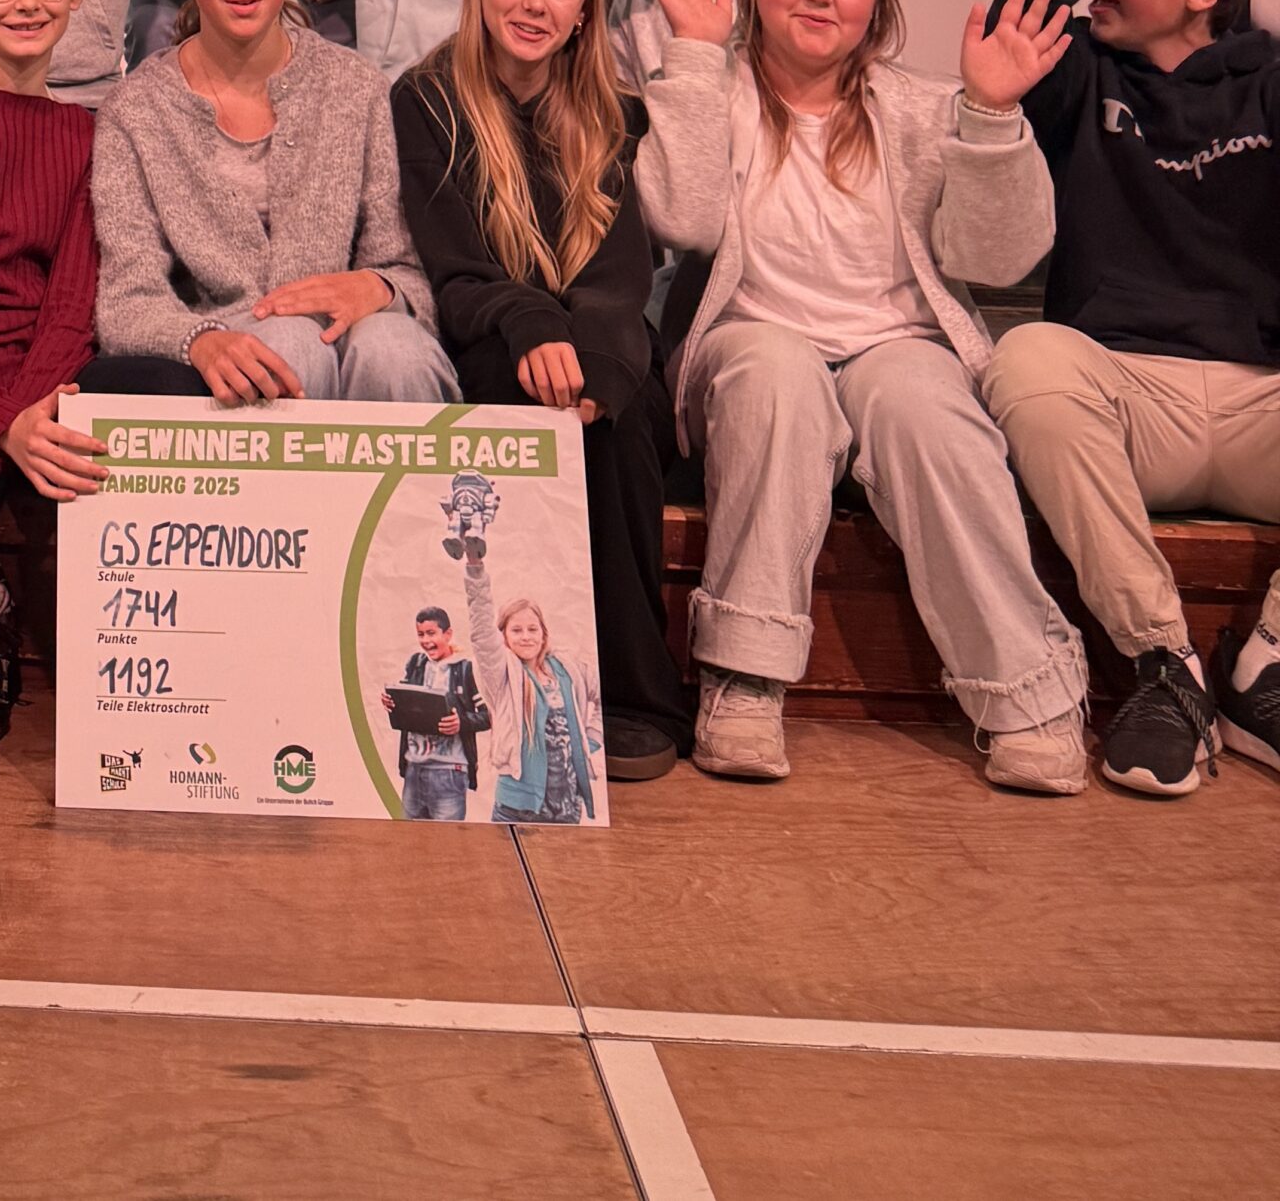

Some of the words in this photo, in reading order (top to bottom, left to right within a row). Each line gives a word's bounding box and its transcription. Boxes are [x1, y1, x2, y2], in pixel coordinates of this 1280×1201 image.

[107, 426, 270, 463] GEWINNER
[283, 431, 437, 466] E-WASTE
[449, 435, 540, 469] RACE
[193, 476, 240, 495] 2025
[100, 520, 141, 567] GS
[146, 520, 309, 570] EPPENDORF
[97, 570, 135, 583] Schule
[102, 587, 178, 628] 1741
[97, 633, 138, 645] Punkte
[98, 656, 173, 697] 1192
[96, 699, 124, 712] Teile
[126, 700, 210, 714] Elektroschrott
[274, 758, 316, 777] HME
[170, 770, 227, 785] HOMANN-
[186, 784, 240, 800] STIFTUNG
